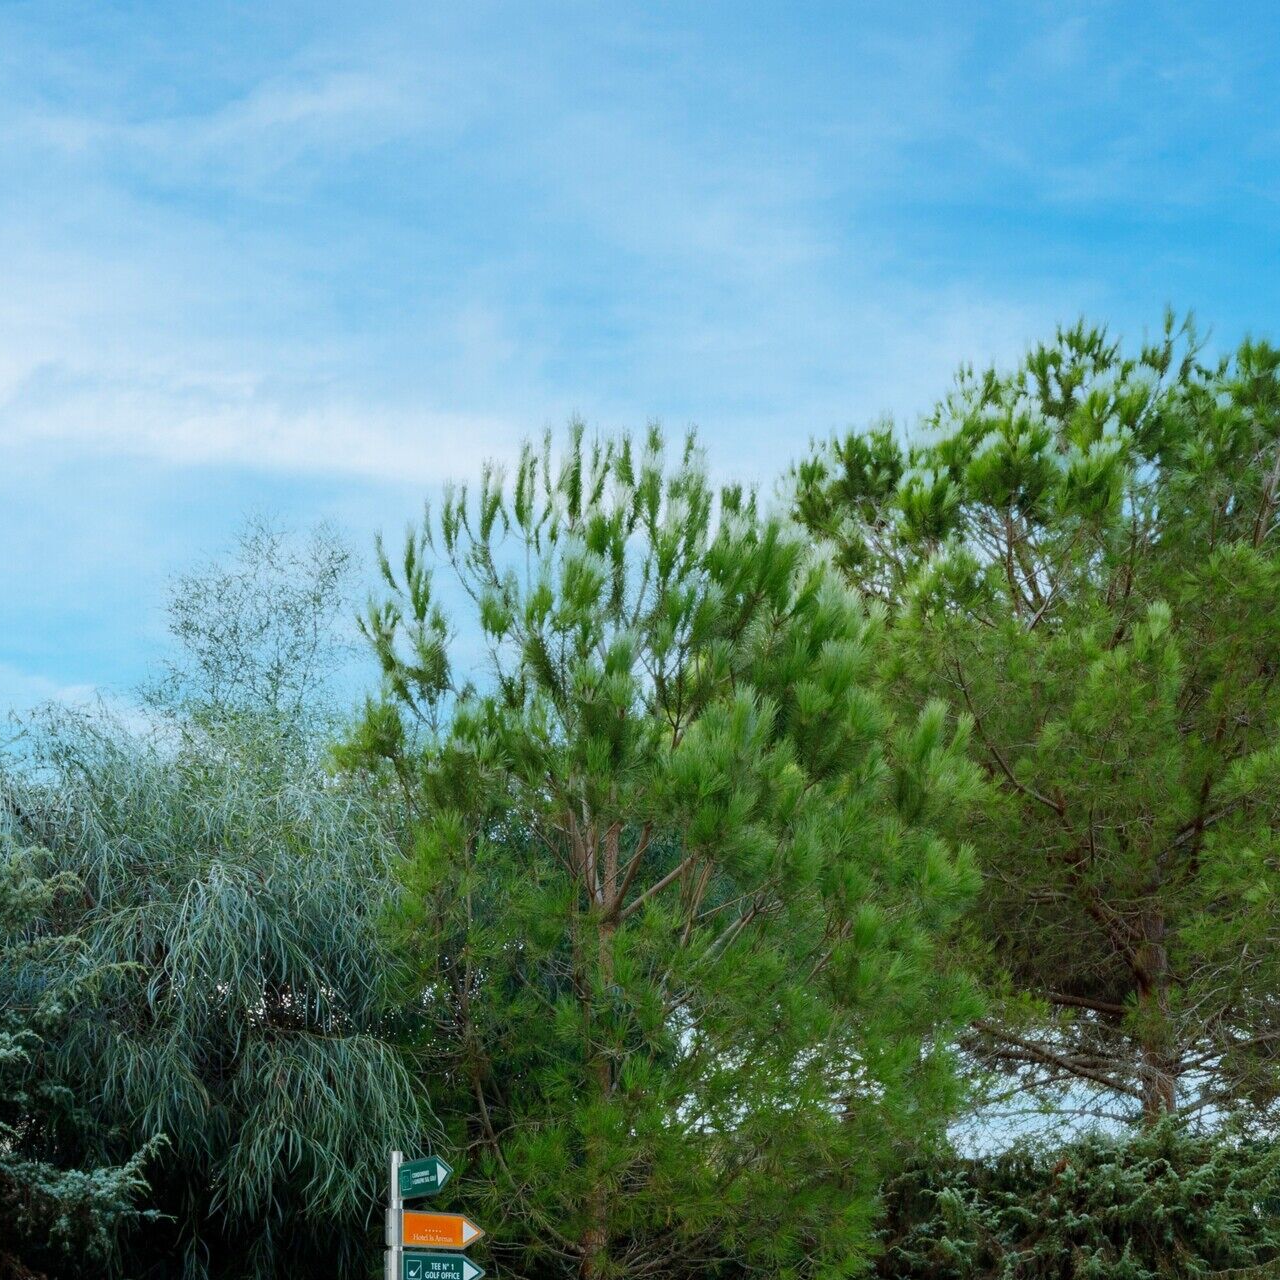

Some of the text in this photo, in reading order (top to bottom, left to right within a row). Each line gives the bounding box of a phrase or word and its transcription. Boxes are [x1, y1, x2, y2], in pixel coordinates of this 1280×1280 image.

[412, 1233, 429, 1241] Hotel
[430, 1262, 441, 1271] TEE
[451, 1263, 455, 1271] 1
[424, 1271, 460, 1280] GOLF OFFICE
